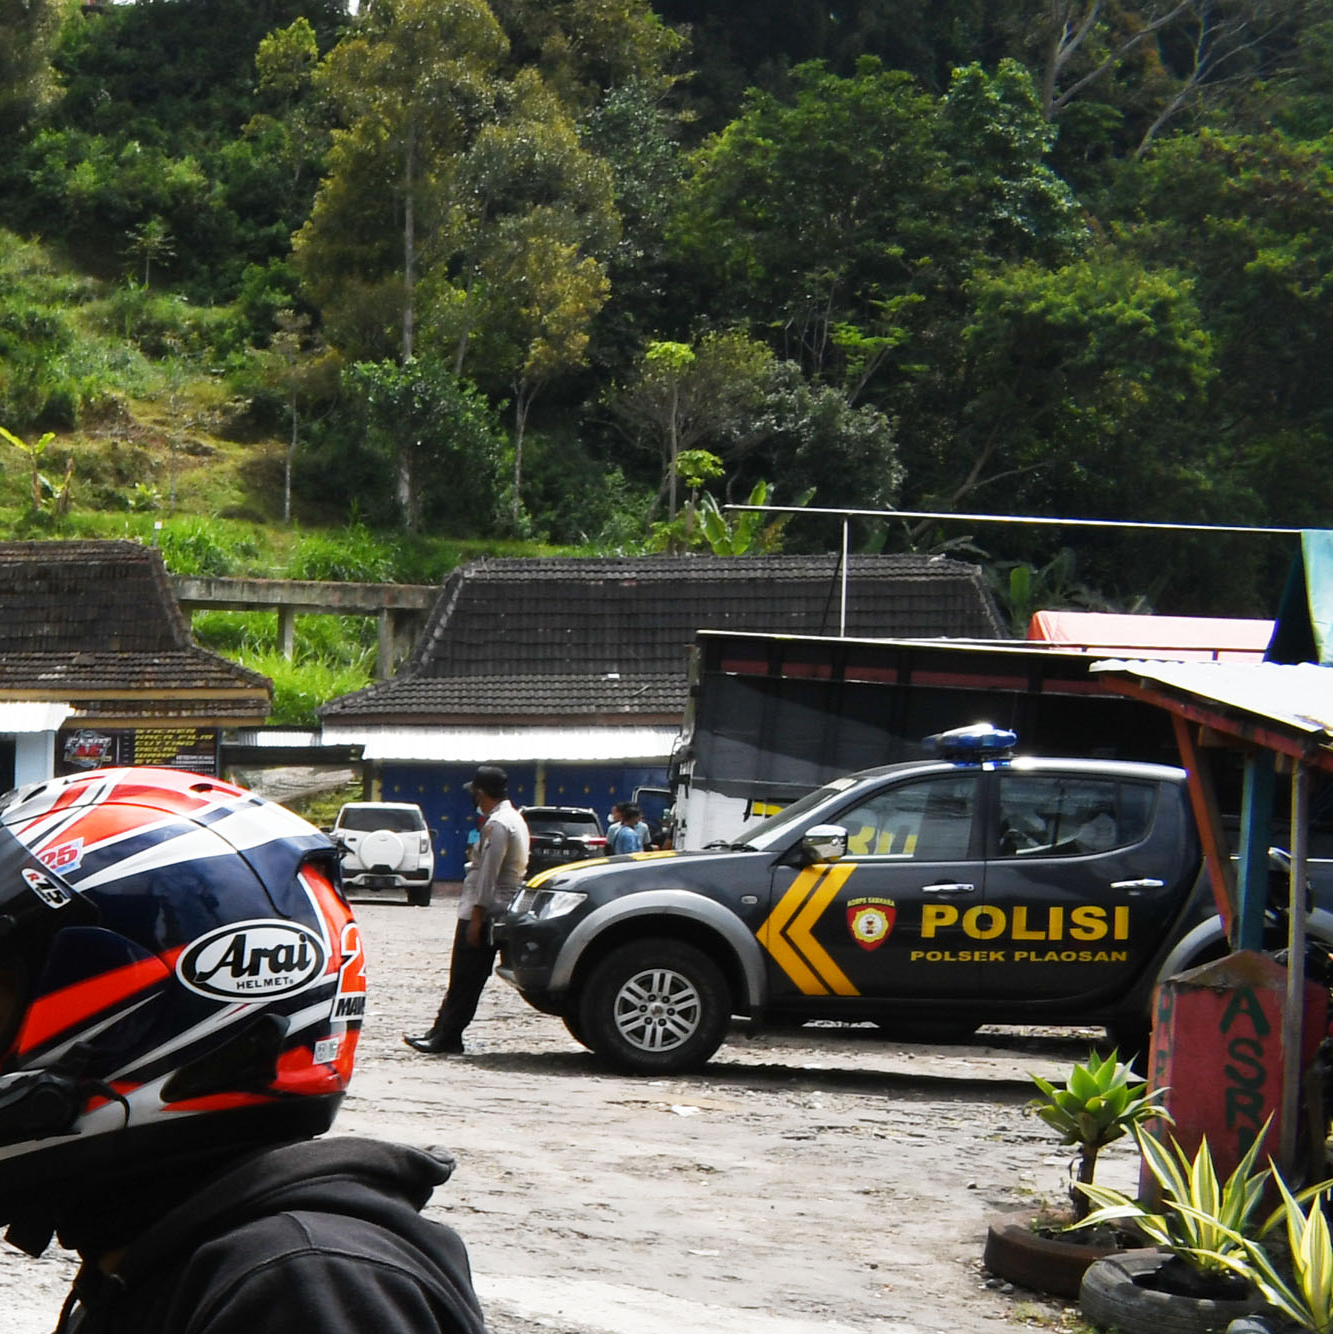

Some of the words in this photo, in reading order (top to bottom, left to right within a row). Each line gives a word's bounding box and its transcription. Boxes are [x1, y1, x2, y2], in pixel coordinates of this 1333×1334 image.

[921, 904, 1129, 941] POLISI
[193, 932, 311, 983] Arai
[910, 951, 1006, 962] POLSEK
[1014, 951, 1127, 962] PLAOSAN
[236, 976, 289, 990] HELMET
